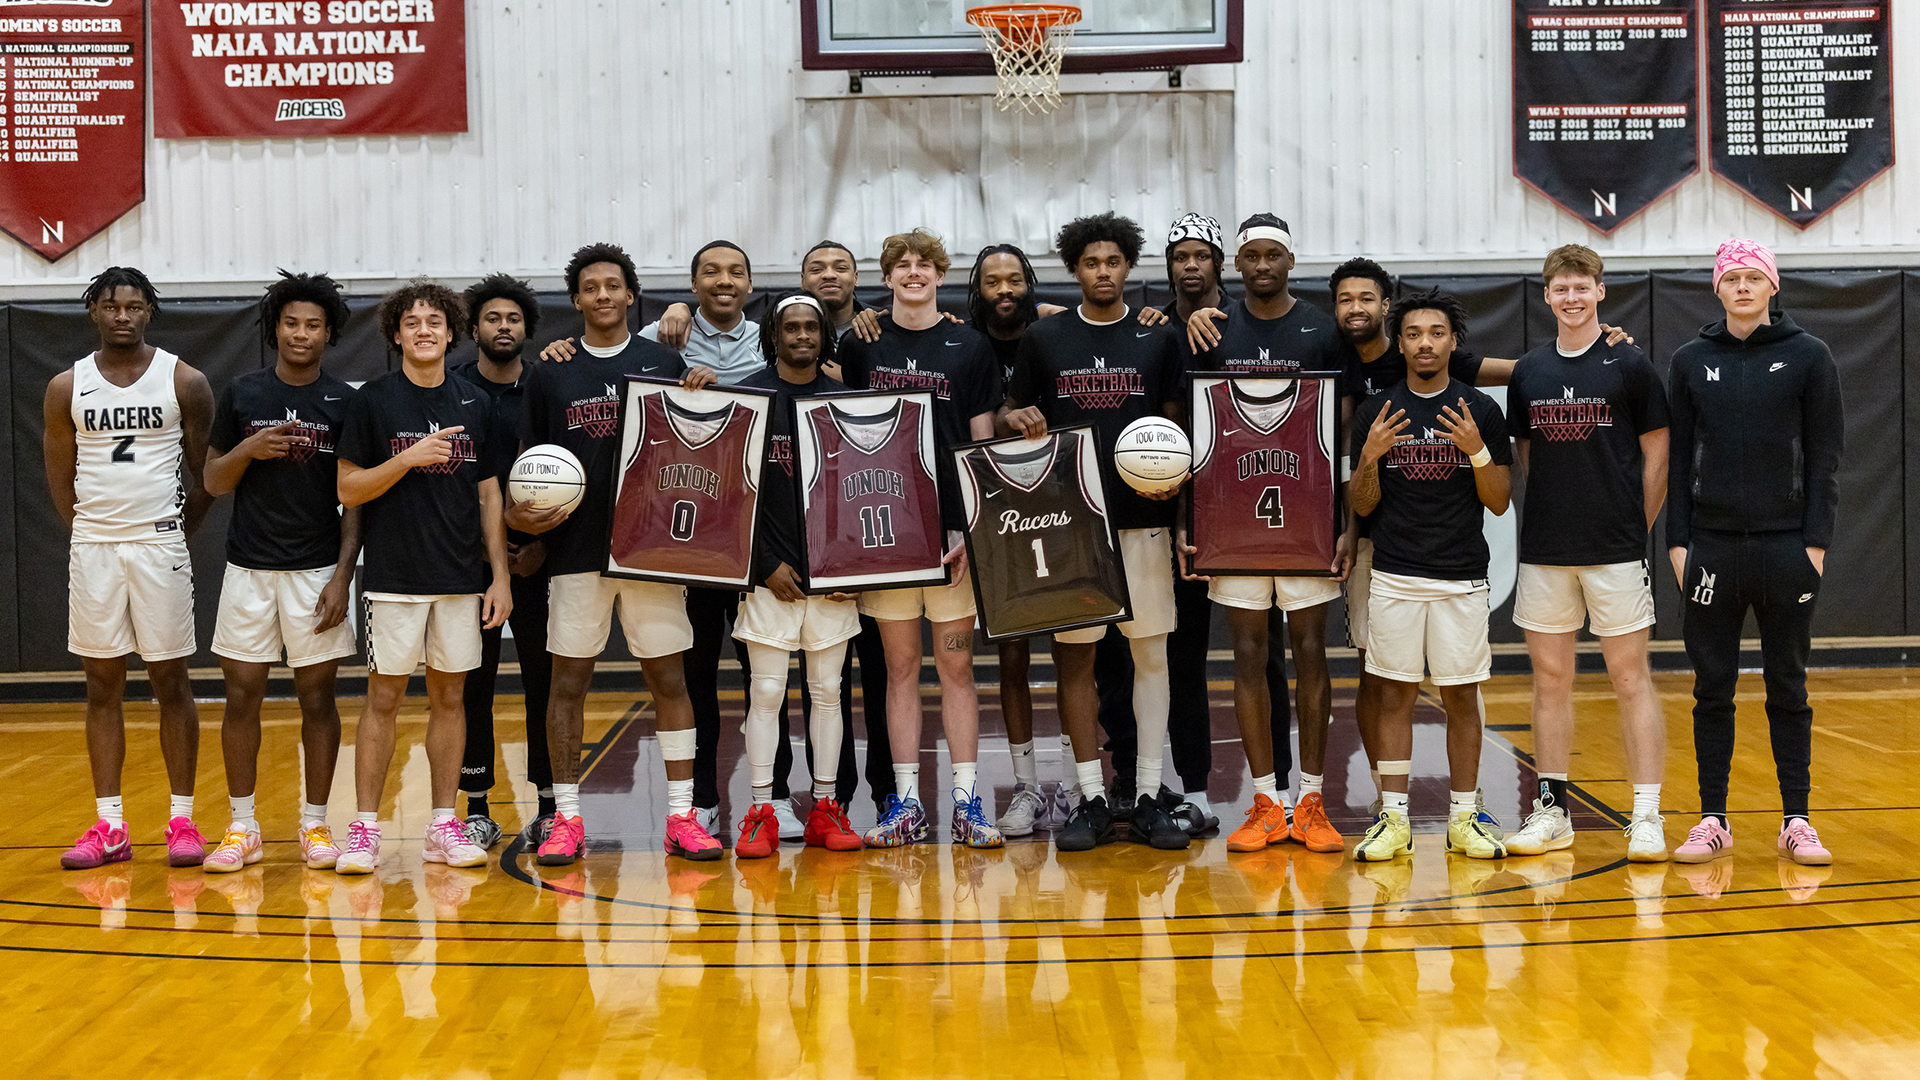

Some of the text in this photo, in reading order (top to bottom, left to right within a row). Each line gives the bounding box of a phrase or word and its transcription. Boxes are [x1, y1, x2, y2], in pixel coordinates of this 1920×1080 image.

[180, 0, 435, 26] WOMEN'S SOCCER
[1724, 10, 1876, 22] NAIA NATIONAL CHAMPIONSHIP
[0, 19, 122, 33] OMEN'S SOCCER
[1532, 16, 1683, 26] WHAC CONFERENCE CHAMPIONS
[1531, 28, 1687, 40] 2015 2016 2017 2018 2019
[1724, 24, 1823, 36] 2013 QUALIFIER
[191, 30, 426, 57] NAIA NATIONAL
[1531, 41, 1625, 51] 2021 2022 2023
[1724, 34, 1872, 48] 2014 QUARTERFINALIST
[5, 44, 130, 53] NATIONAL CHAMPIONSHIP
[1725, 46, 1878, 60] 2015 REGIONAL FINALIST
[14, 57, 69, 67] NATIONAL
[71, 56, 134, 67] RUNNER-UP
[1725, 60, 1824, 72] 2016 QUALIFIER
[14, 68, 99, 78] SEMIFINALIST
[224, 61, 394, 87] CHAMPIONS
[1725, 70, 1872, 84] 2017 QUARTERFINALIST
[14, 80, 69, 90] NATIONAL
[71, 80, 134, 90] CHAMPIONS
[1725, 84, 1825, 96] 2018 QUALIFIER
[14, 91, 99, 101] SEMIFINALIST
[1726, 96, 1826, 108] 2019 QUALIFIER
[14, 103, 78, 113] QUALIFIER
[277, 100, 344, 119] RACERS
[1528, 106, 1686, 116] WHAC TOURNAMENT CHAMPIONS
[1726, 108, 1825, 120] 2021 QUALIFIER
[14, 115, 125, 125] QUARTERFINALIST
[1529, 118, 1686, 129] 2015 2016 2017 2018 2019
[1727, 118, 1874, 132] 2022 QUARTERFINALIST
[14, 127, 76, 137] QUALIFIER
[1529, 130, 1654, 141] 2021 2022 2023 2024
[1727, 131, 1848, 143] 2023 SEMIFINALIST
[15, 139, 78, 149] QUALIFIER
[1728, 143, 1848, 155] 2024 SEMIFINALIST
[15, 151, 78, 162] QUALIFIER
[1261, 359, 1300, 367] RELENTLESS
[891, 367, 908, 375] MEN'S
[908, 369, 945, 379] RELENTLESS
[1704, 364, 1720, 381] N
[1056, 374, 1144, 395] BASKETBALL
[571, 399, 588, 407] UNOH
[1565, 397, 1606, 405] RELENTLESS
[83, 406, 164, 431] RACERS
[565, 401, 620, 426] BASKET
[1529, 404, 1613, 425] BASKETBALL
[289, 420, 329, 431] ENTLESS
[1136, 431, 1177, 444] 1000 POINTS
[111, 435, 136, 463] 2
[518, 462, 560, 475] 1000 POINTS
[1236, 449, 1300, 481] UNOH
[658, 463, 722, 500] UNOH
[842, 468, 905, 502] UNOH
[1256, 486, 1284, 528] 4
[670, 499, 697, 542] 0
[997, 509, 1072, 535] Racers
[859, 505, 896, 549] 11
[1031, 538, 1049, 578] 1
[1691, 585, 1714, 605] 10
[461, 766, 486, 774] deuce
